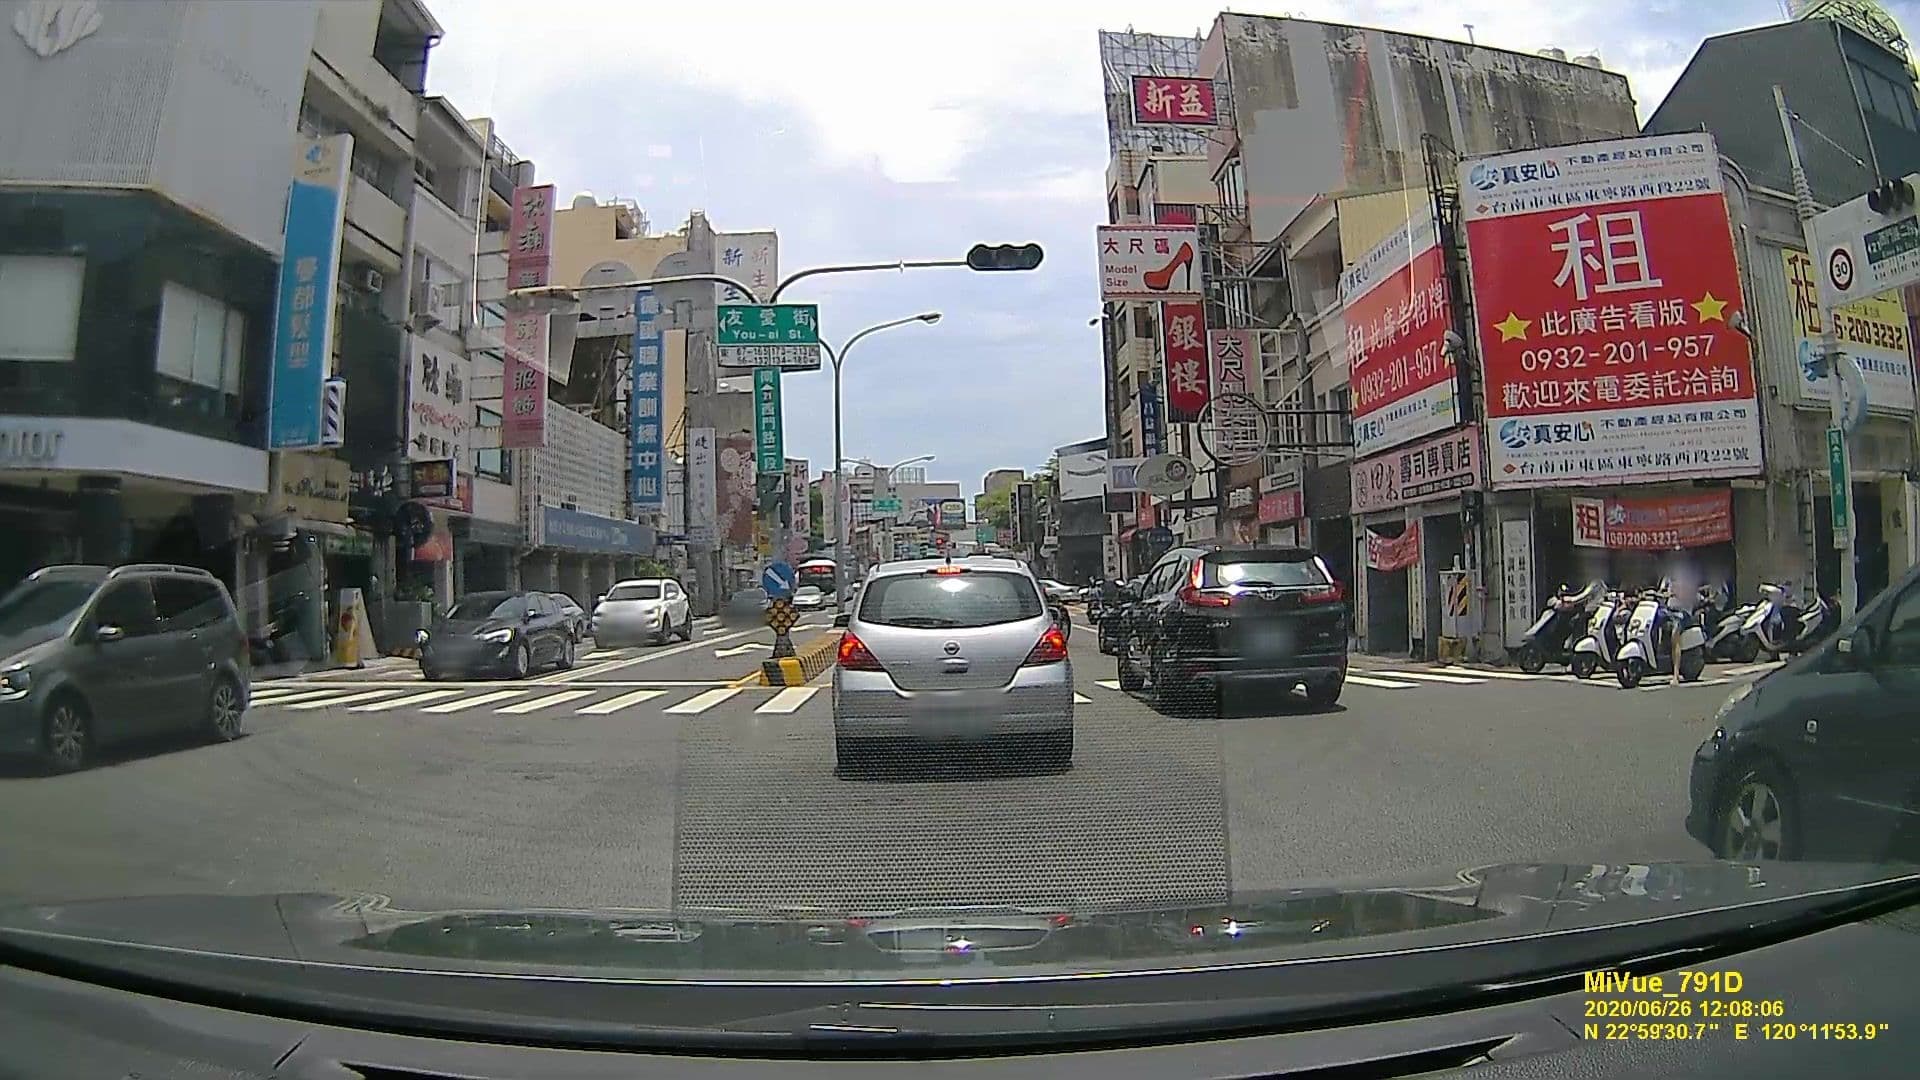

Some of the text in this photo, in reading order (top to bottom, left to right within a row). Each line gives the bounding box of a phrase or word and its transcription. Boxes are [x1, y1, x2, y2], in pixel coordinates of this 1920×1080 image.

[1143, 79, 1209, 119] 新益
[1501, 159, 1561, 185] 真安心
[1103, 237, 1170, 255] 大尺碼
[1548, 210, 1662, 302] 租
[1105, 264, 1138, 275] Model
[1105, 276, 1129, 288] Size
[1835, 260, 1849, 278] 30
[726, 308, 810, 327] 友愛街
[733, 330, 779, 340] You-ai
[1540, 298, 1688, 338] 此廣告看版
[1168, 314, 1207, 394] 銀樓
[1346, 319, 1369, 377] 租
[1521, 335, 1715, 372] 0932-201-957
[1360, 340, 1438, 407] 0932-201-957
[1501, 364, 1739, 411] 歡迎來電委託洽詢
[1533, 420, 1595, 445] 真安心
[1400, 436, 1471, 484] 壽司專賣店
